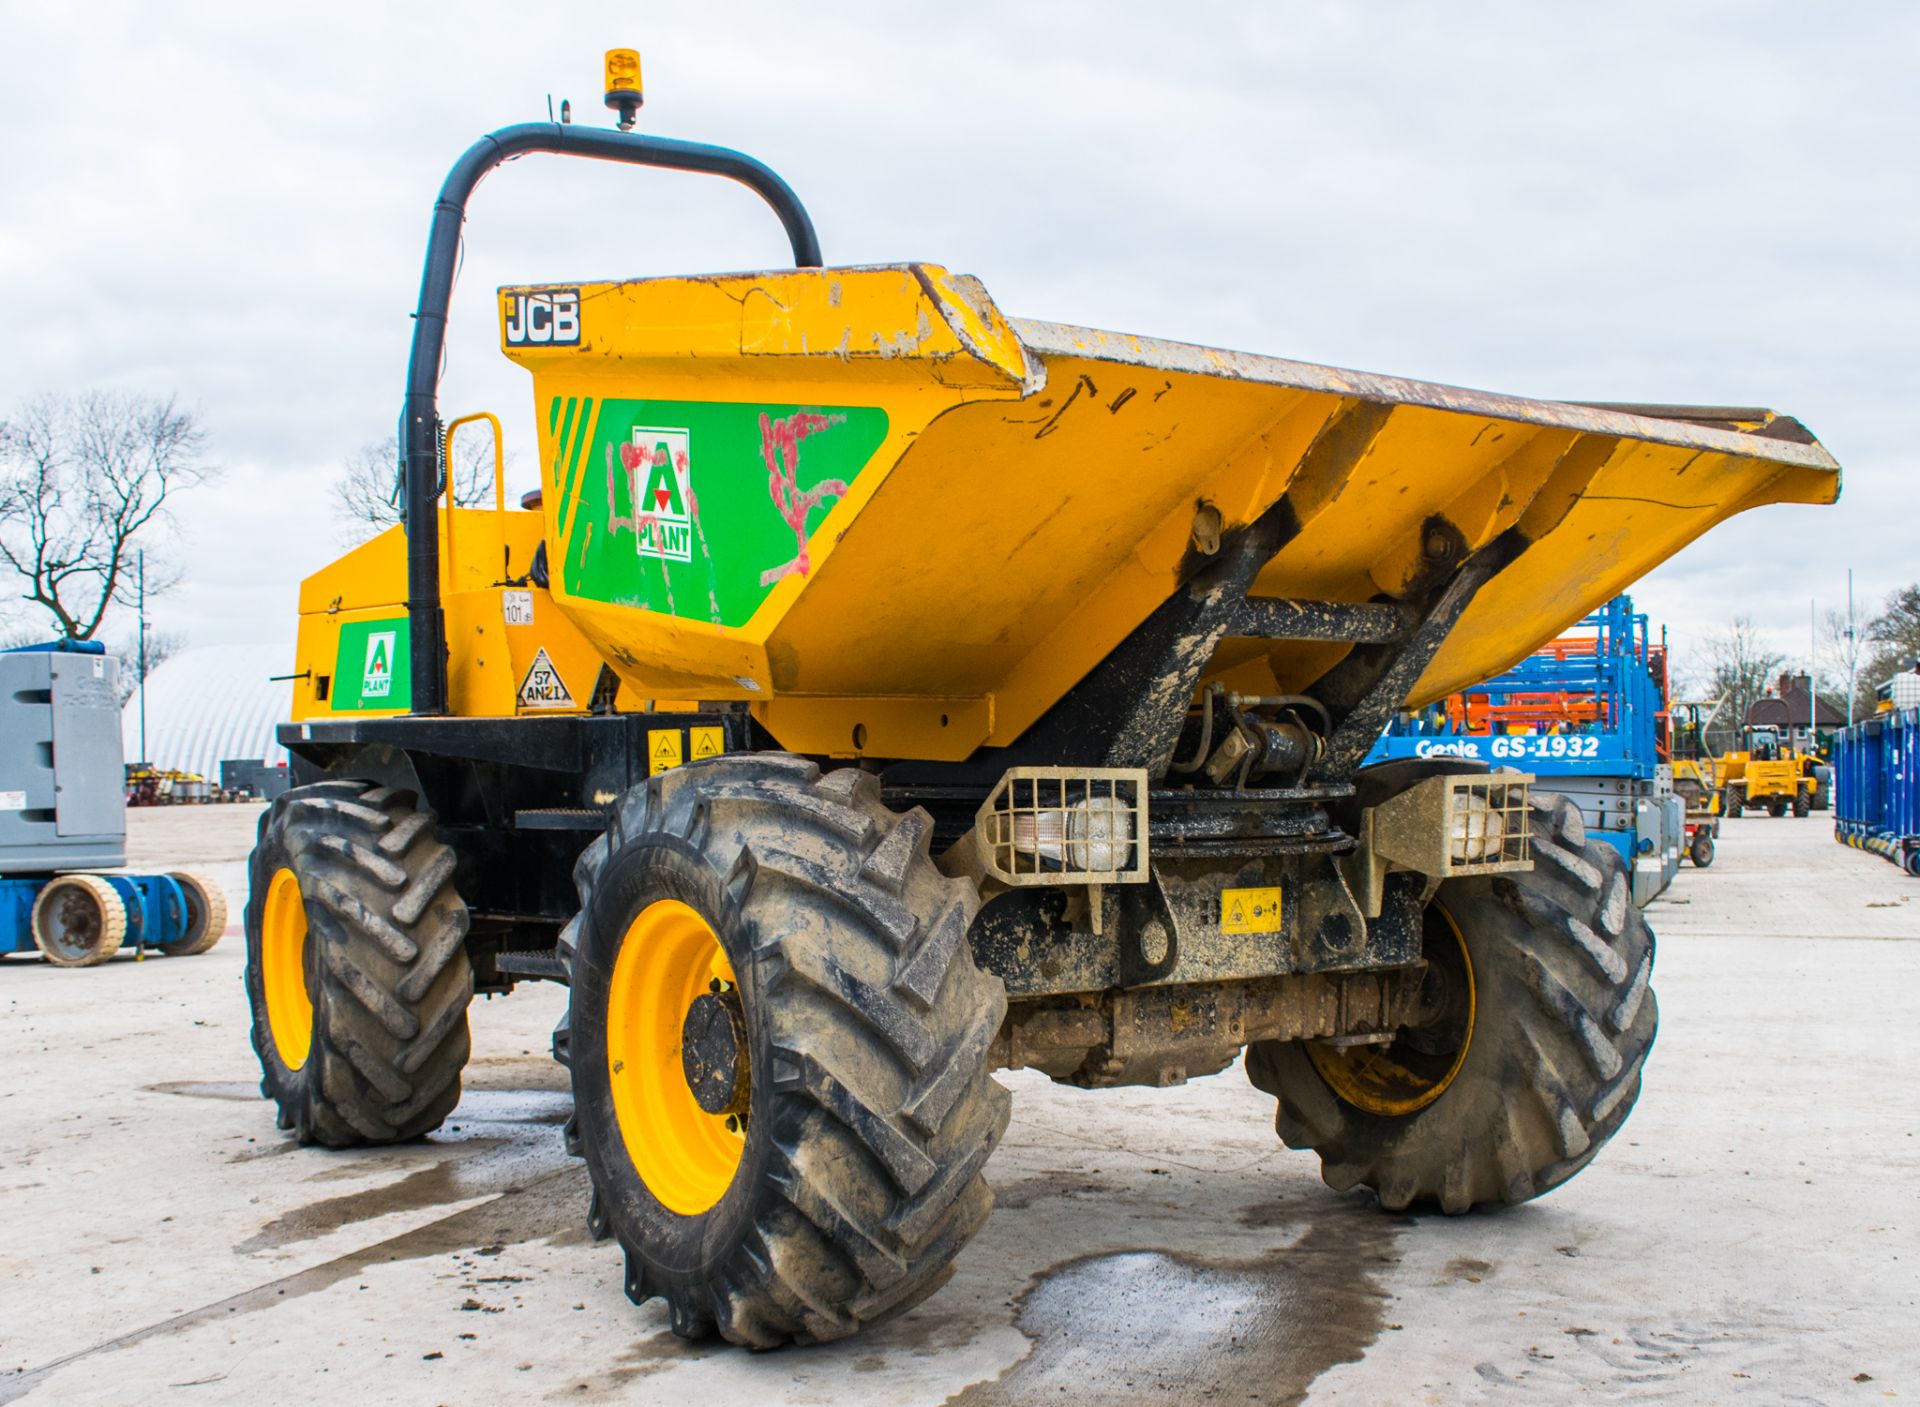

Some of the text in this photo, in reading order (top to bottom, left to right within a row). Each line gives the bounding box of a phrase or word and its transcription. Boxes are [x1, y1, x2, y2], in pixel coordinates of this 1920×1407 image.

[507, 293, 580, 342] JCB
[641, 441, 686, 516] A
[505, 605, 521, 622] 101
[367, 639, 388, 674] A
[363, 679, 389, 692] PLANT
[534, 671, 551, 685] 57
[1415, 736, 1599, 759] Genie GS-1932
